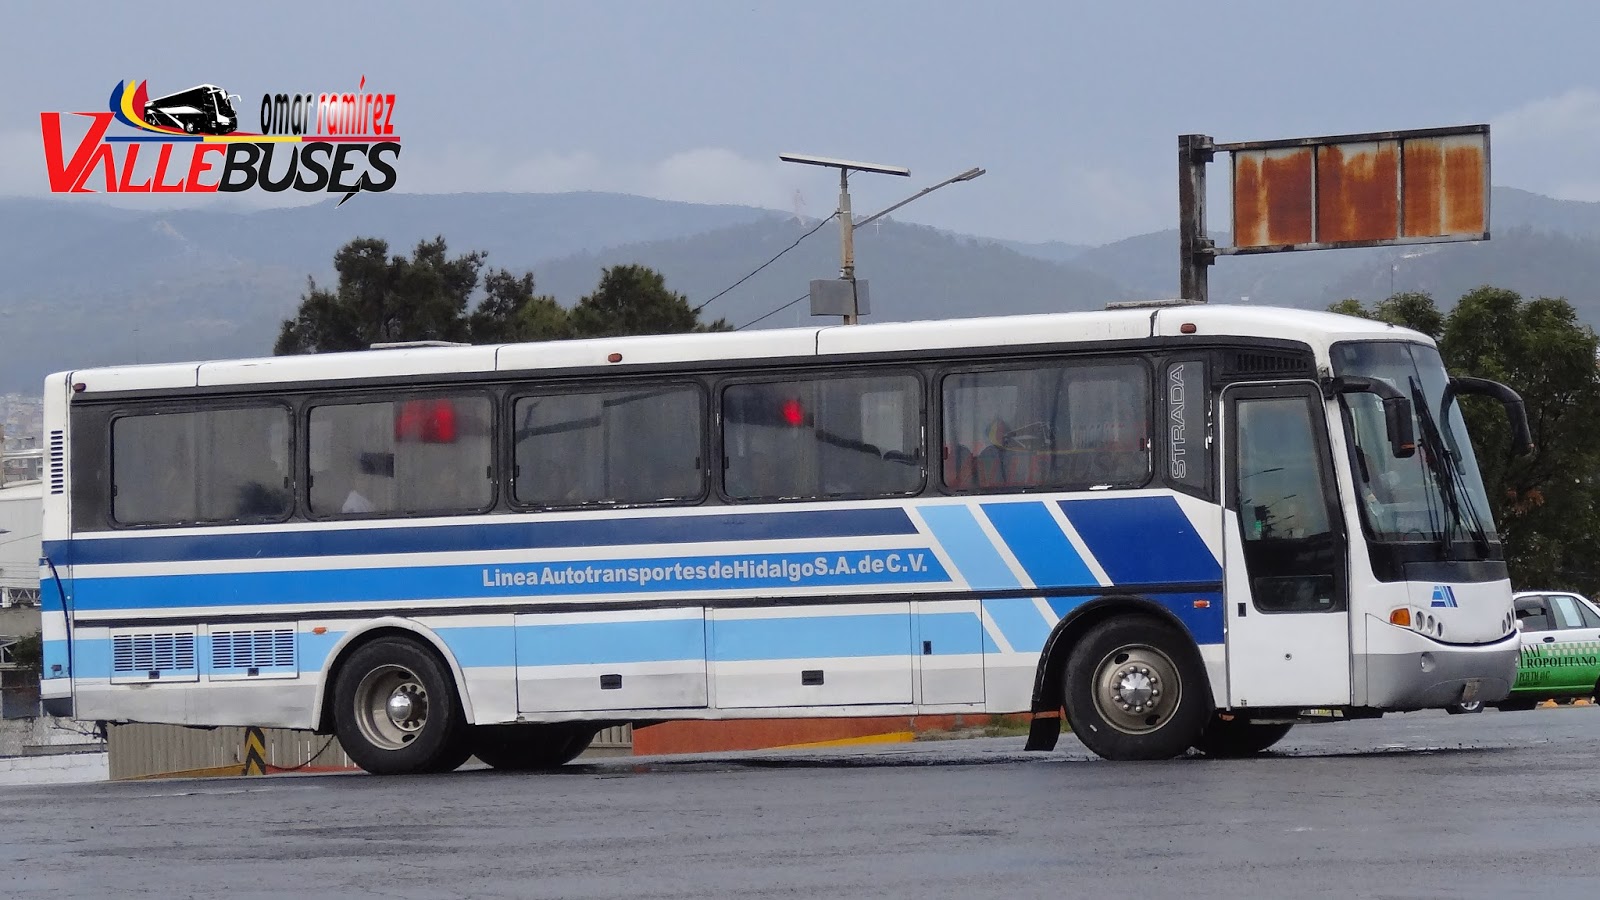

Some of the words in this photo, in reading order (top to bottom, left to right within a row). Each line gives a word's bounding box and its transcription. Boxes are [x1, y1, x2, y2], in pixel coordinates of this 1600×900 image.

[1169, 364, 1187, 479] STRADA
[482, 569, 538, 587] Linea
[540, 562, 706, 586] Autotransportes
[734, 560, 814, 582] Hidalgo
[814, 556, 857, 575] S.A.
[886, 553, 928, 573] C.V.
